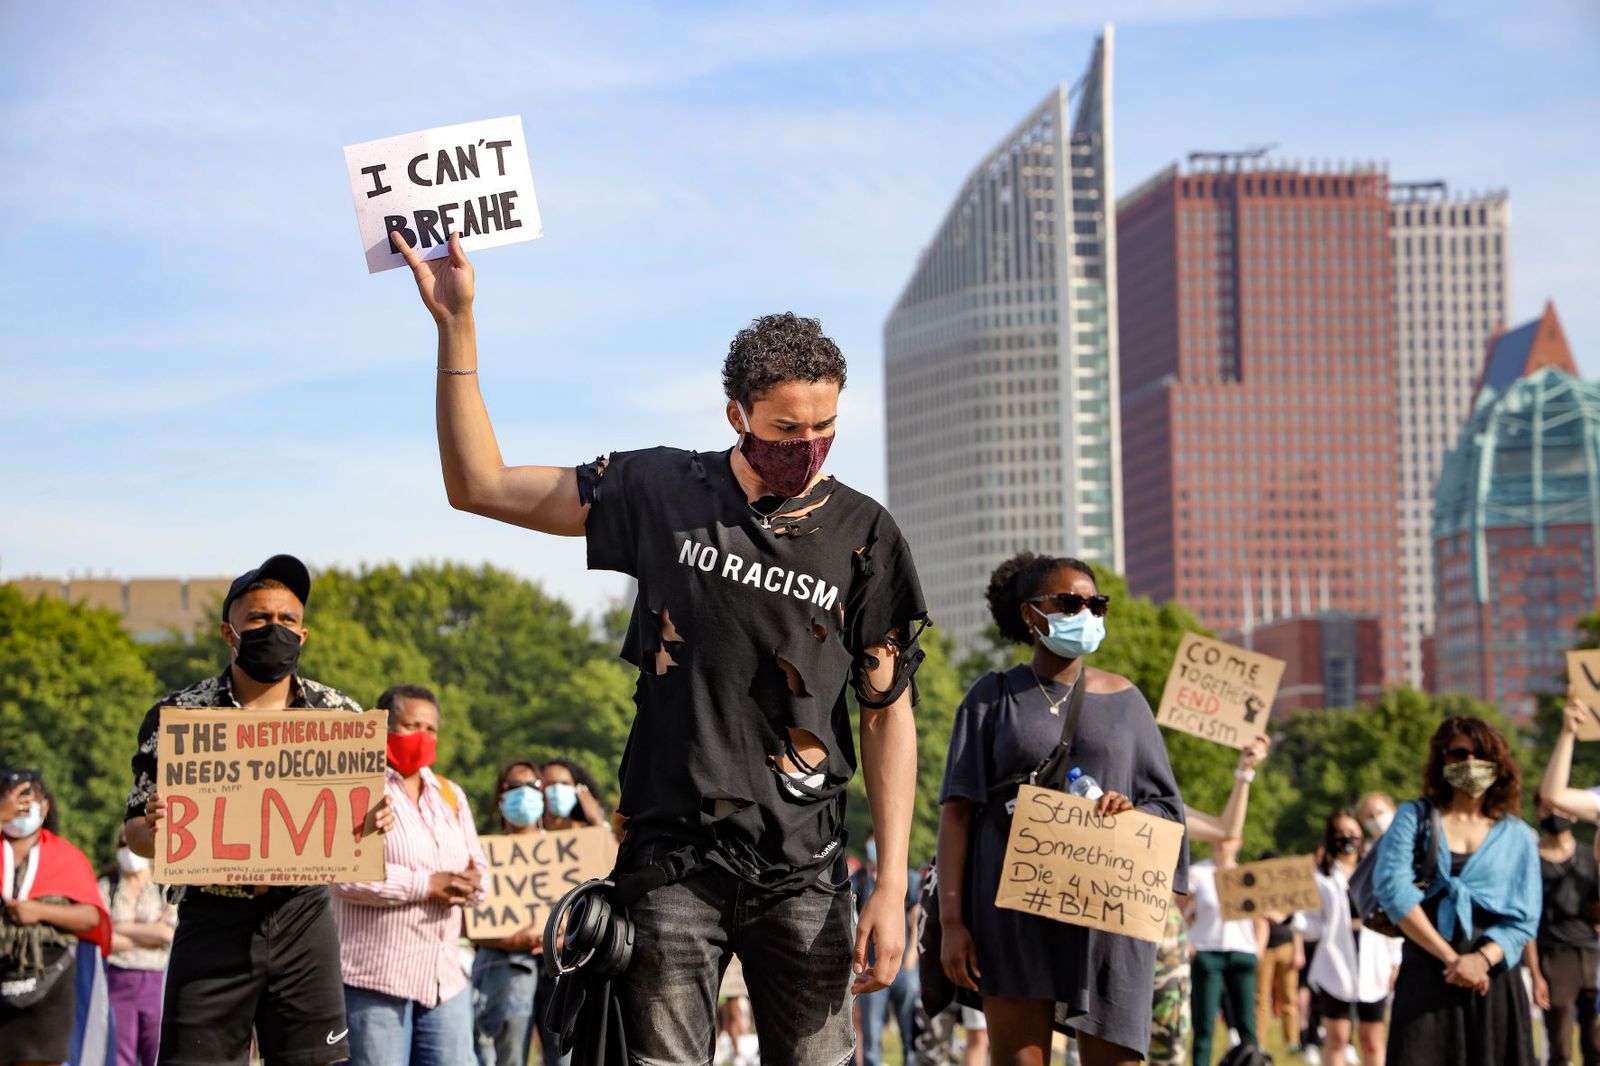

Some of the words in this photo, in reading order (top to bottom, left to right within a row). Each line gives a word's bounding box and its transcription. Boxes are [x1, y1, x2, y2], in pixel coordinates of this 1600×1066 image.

[361, 163, 392, 198] I
[407, 138, 512, 187] CAN'T
[678, 539, 719, 572] NO
[721, 553, 839, 611] RACISM
[1177, 686, 1220, 716] END
[166, 723, 227, 755] THE
[236, 720, 378, 749] NETHERLANDS
[166, 760, 240, 786] NEEDS
[247, 760, 275, 781] TO
[166, 787, 370, 864] BLM!
[1135, 822, 1153, 849] 4
[489, 837, 580, 867] LACK
[1014, 827, 1134, 881] Something
[1142, 870, 1167, 889] OR
[492, 868, 584, 900] IVES
[1009, 861, 1054, 885] Die
[1068, 874, 1080, 898] 4
[1091, 880, 1168, 923] Nothing
[1022, 887, 1124, 925] #BLM
